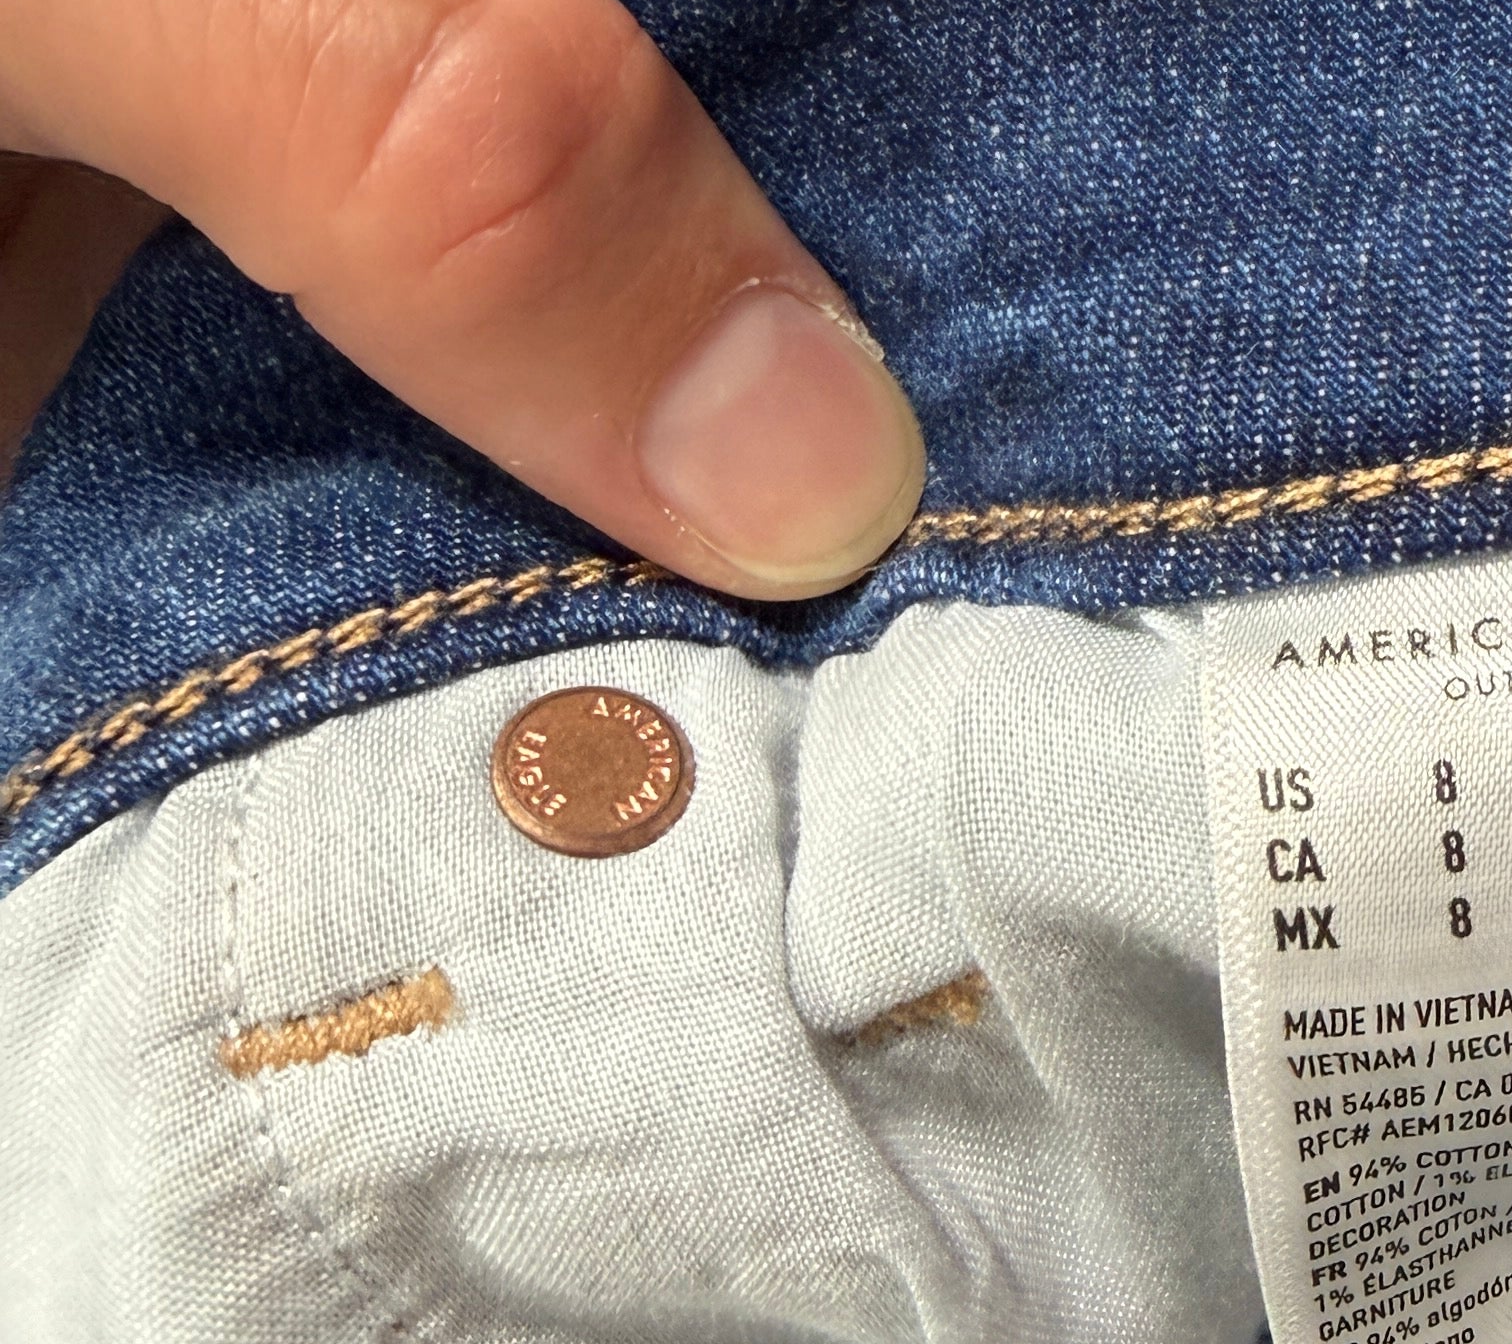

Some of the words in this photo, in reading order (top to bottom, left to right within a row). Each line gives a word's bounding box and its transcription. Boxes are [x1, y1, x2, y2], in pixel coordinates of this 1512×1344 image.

[1257, 766, 1314, 813] US
[1433, 758, 1458, 805] 8
[1266, 836, 1327, 883] CA
[1442, 830, 1466, 873] 8
[1273, 904, 1341, 952] MX
[1449, 896, 1472, 939] 8
[1284, 1006, 1366, 1041] MADE
[1376, 1001, 1405, 1035] IN
[1287, 1045, 1417, 1080] VIETNAM
[1426, 1040, 1436, 1069] /
[1294, 1096, 1333, 1125] RN
[1341, 1085, 1426, 1115] 54485
[1434, 1080, 1447, 1107] /
[1455, 1078, 1492, 1102] CA
[1298, 1122, 1371, 1163] RFC#
[1303, 1171, 1342, 1204] EN
[1349, 1154, 1407, 1187] 94%
[1307, 1180, 1405, 1233] COTTON
[1413, 1174, 1425, 1196] /
[1309, 1191, 1466, 1261] DECORATION
[1311, 1260, 1349, 1288] FR
[1354, 1237, 1411, 1272] 94%
[1417, 1204, 1497, 1247] COTON
[1313, 1286, 1355, 1314] 1%
[1318, 1269, 1457, 1343] GARNITURE
